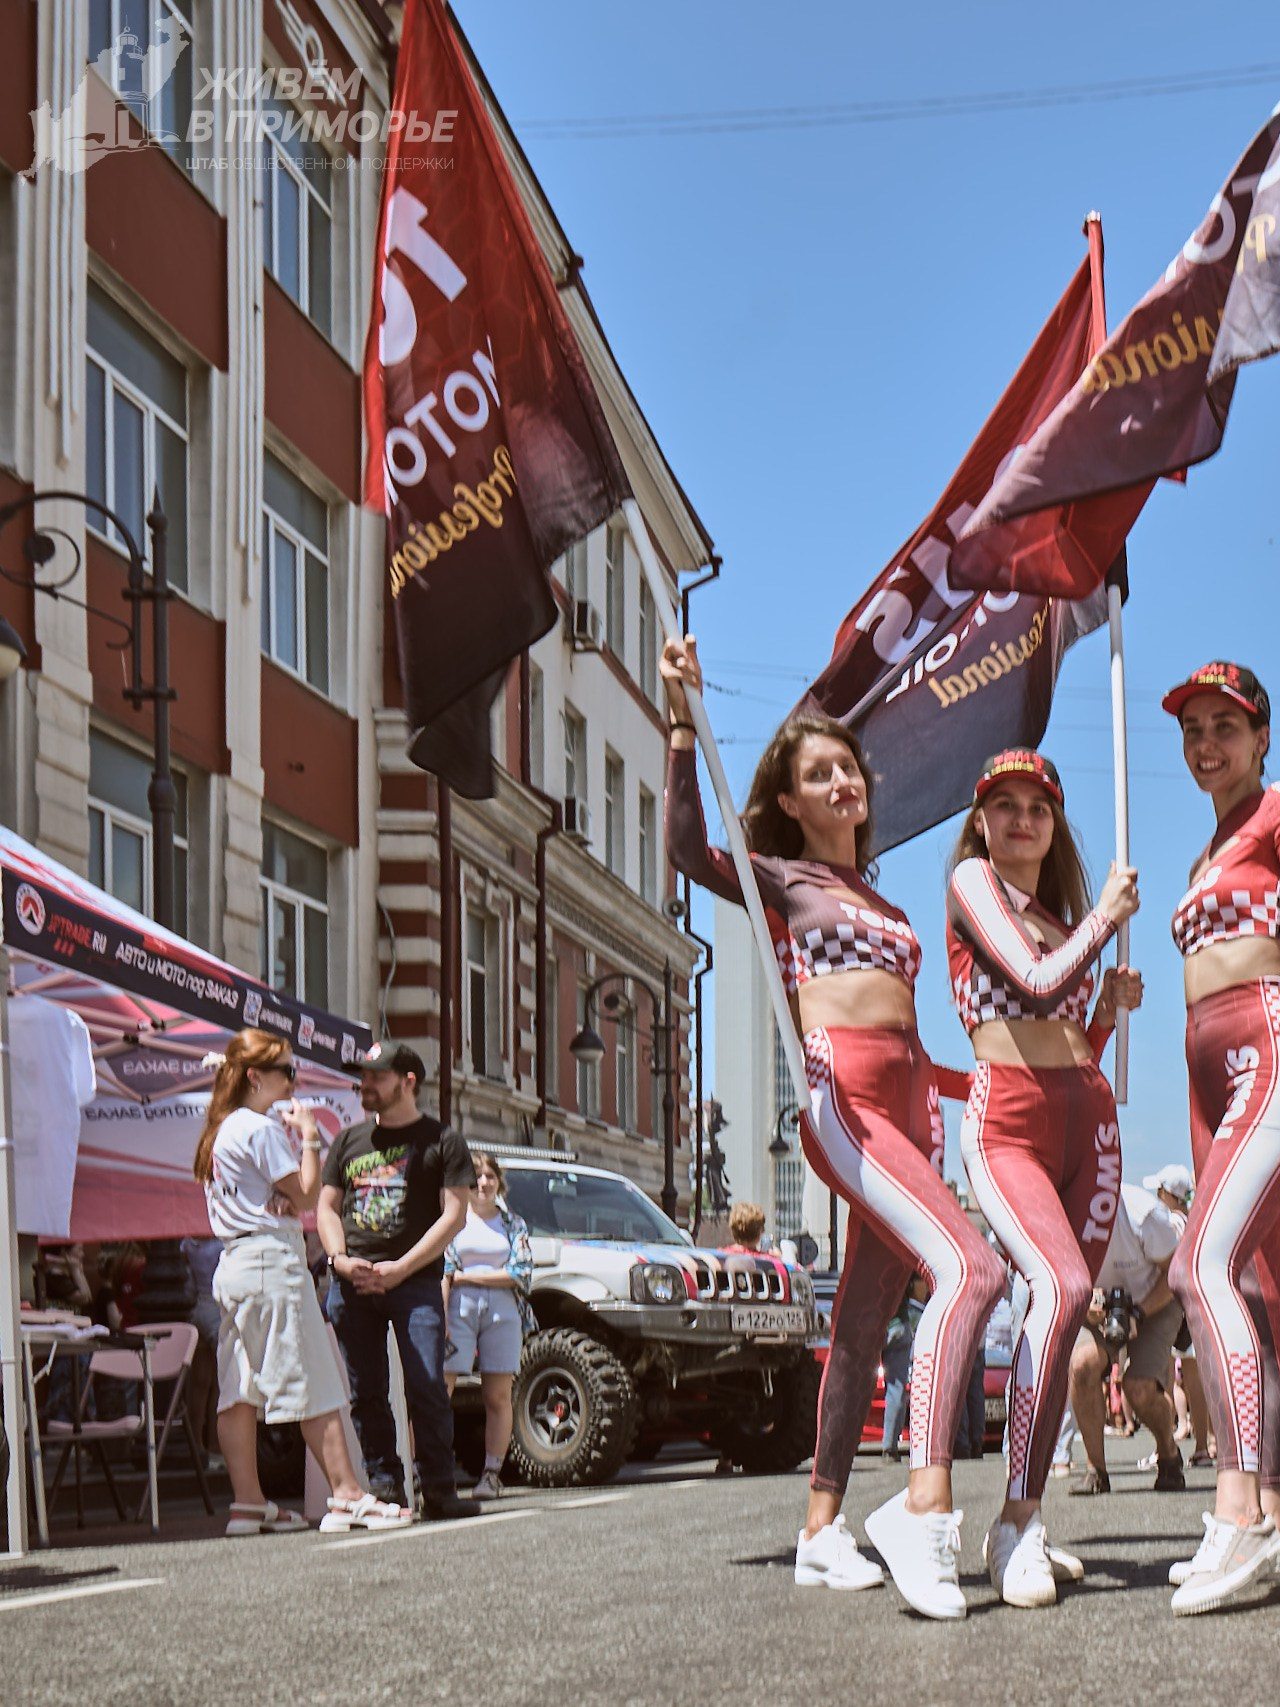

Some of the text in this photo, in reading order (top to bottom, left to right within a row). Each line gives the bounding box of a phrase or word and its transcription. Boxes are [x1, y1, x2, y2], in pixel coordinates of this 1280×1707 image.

[840, 901, 913, 941] TOM
[926, 1084, 945, 1173] OM'S
[1082, 1121, 1121, 1244] TOM'S
